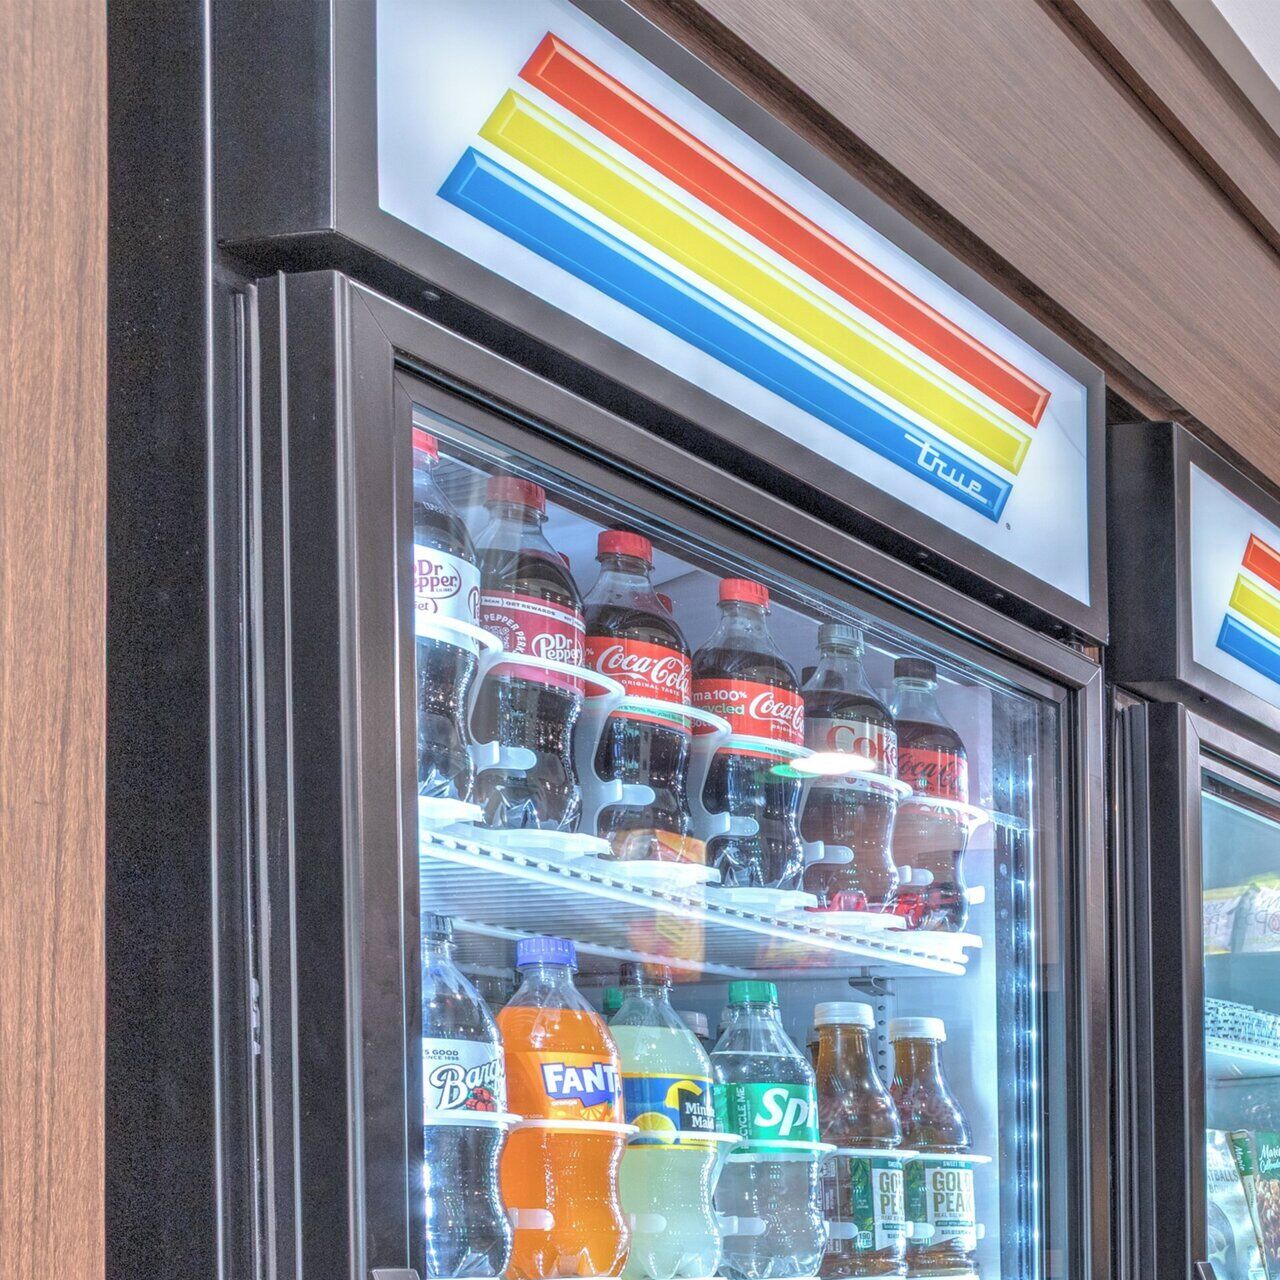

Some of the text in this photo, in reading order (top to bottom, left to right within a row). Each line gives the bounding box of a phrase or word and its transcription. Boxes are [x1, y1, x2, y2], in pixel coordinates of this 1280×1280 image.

[904, 432, 988, 504] true
[556, 635, 572, 649] Dr
[597, 645, 690, 692] Coca-Cola
[622, 679, 659, 690] ORIGINAL
[714, 689, 748, 701] 100%
[432, 1049, 459, 1057] GOOD
